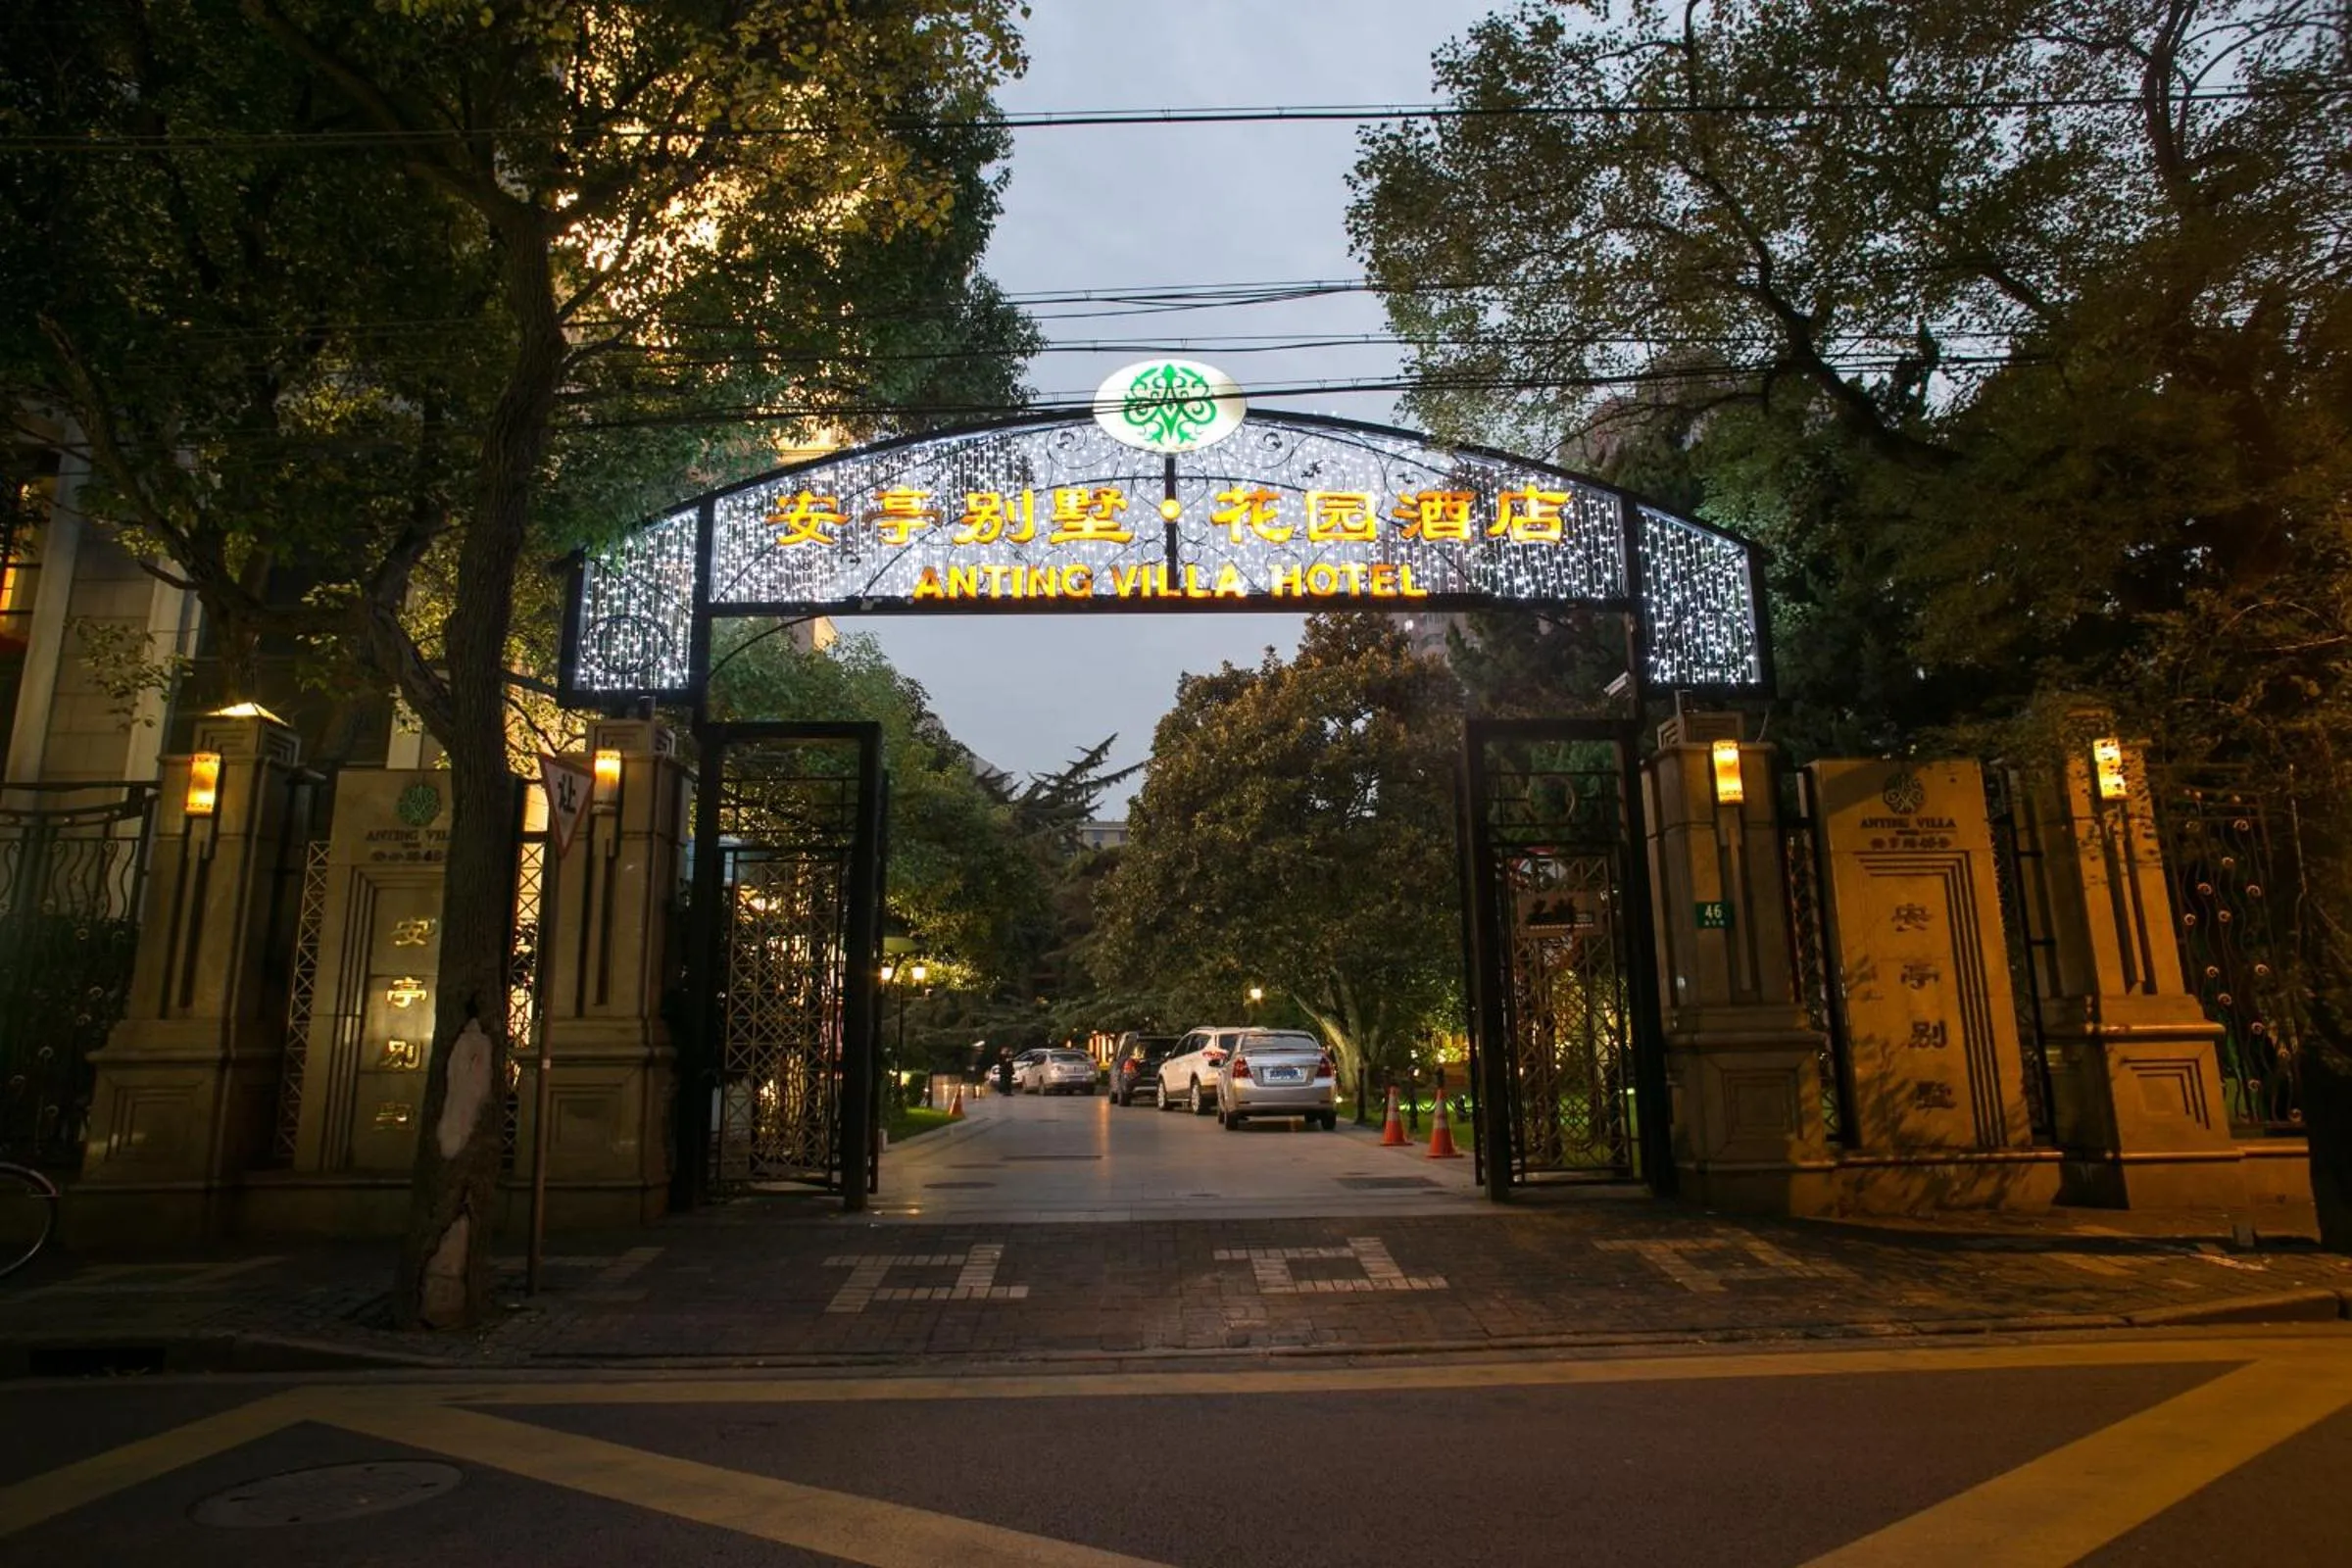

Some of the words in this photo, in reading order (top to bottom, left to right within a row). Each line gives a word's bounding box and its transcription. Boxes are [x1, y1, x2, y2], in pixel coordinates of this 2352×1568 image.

[912, 564, 1094, 600] ANTING
[1111, 564, 1247, 599] VILLA
[1274, 564, 1428, 598] HOTEL
[558, 773, 576, 814] 让
[1705, 904, 1723, 919] 46
